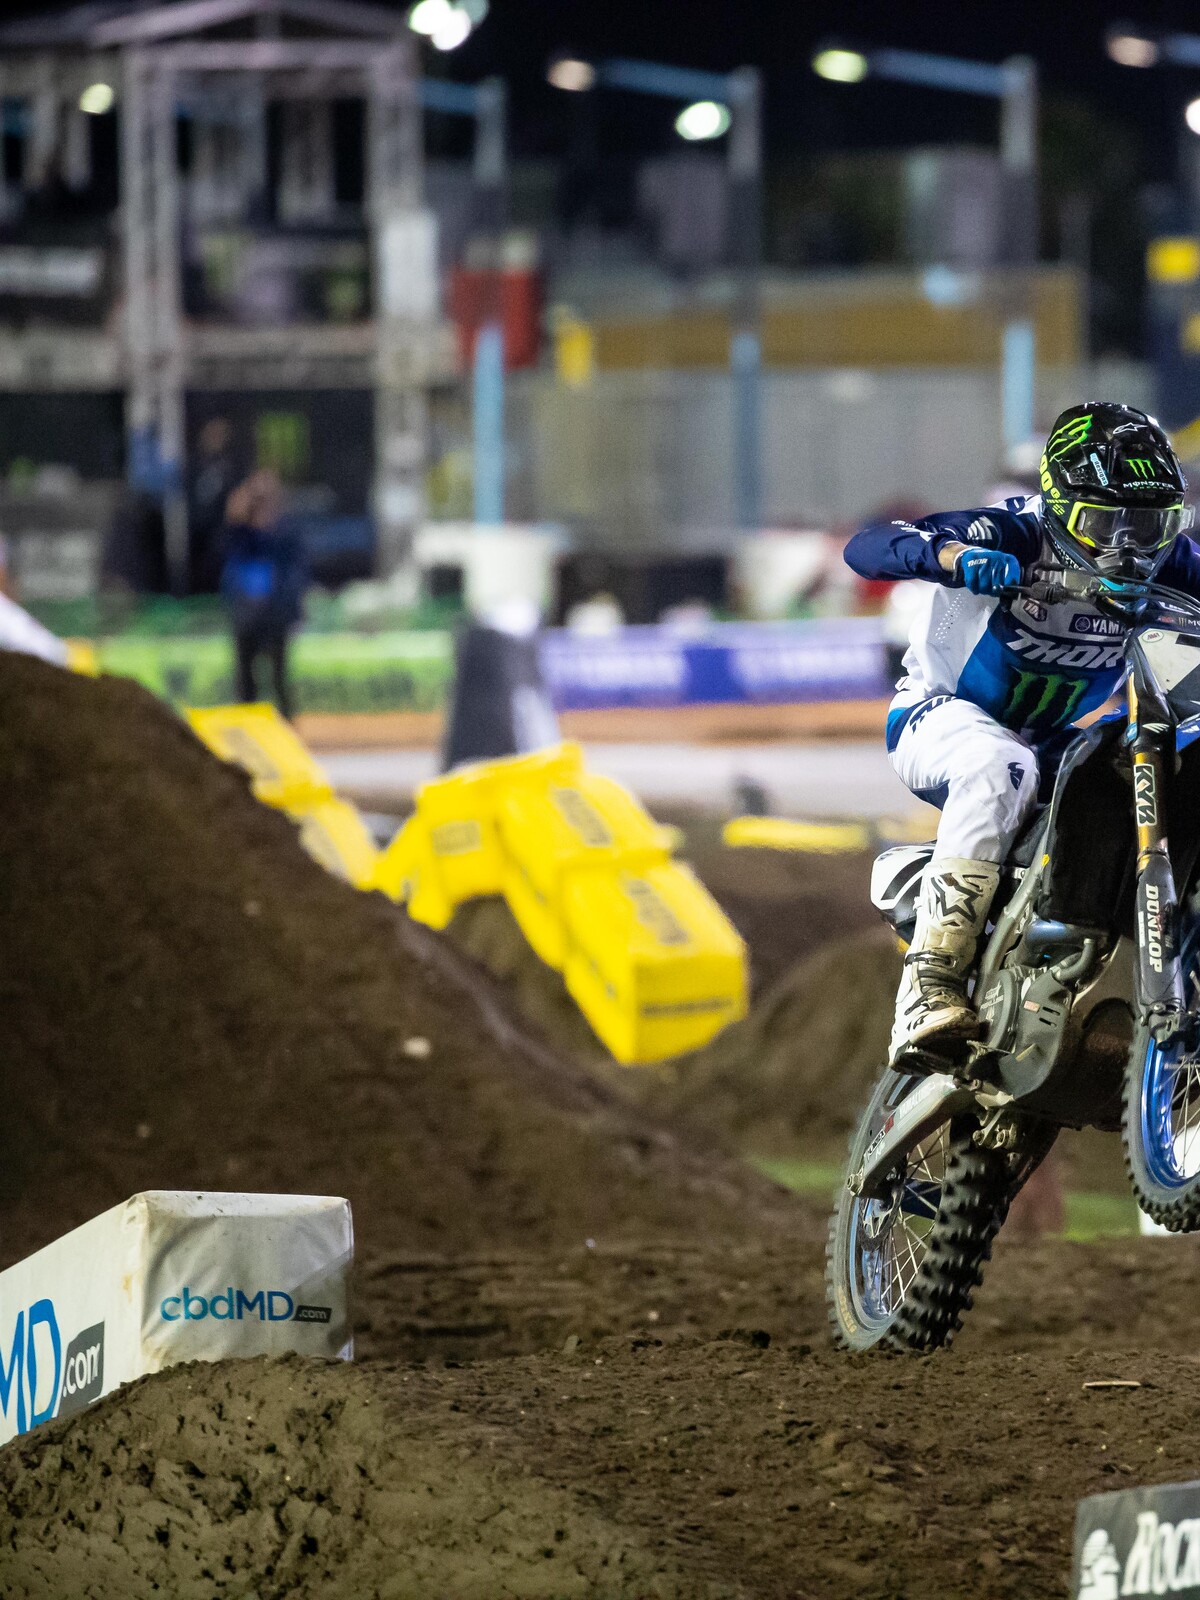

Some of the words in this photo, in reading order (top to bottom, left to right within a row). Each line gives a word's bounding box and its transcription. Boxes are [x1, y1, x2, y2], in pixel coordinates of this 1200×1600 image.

[1123, 481, 1176, 490] MONSTER
[967, 558, 988, 567] THOR
[1006, 628, 1124, 669] THOR
[1135, 764, 1157, 826] KYB
[1146, 884, 1163, 973] DUNLOP
